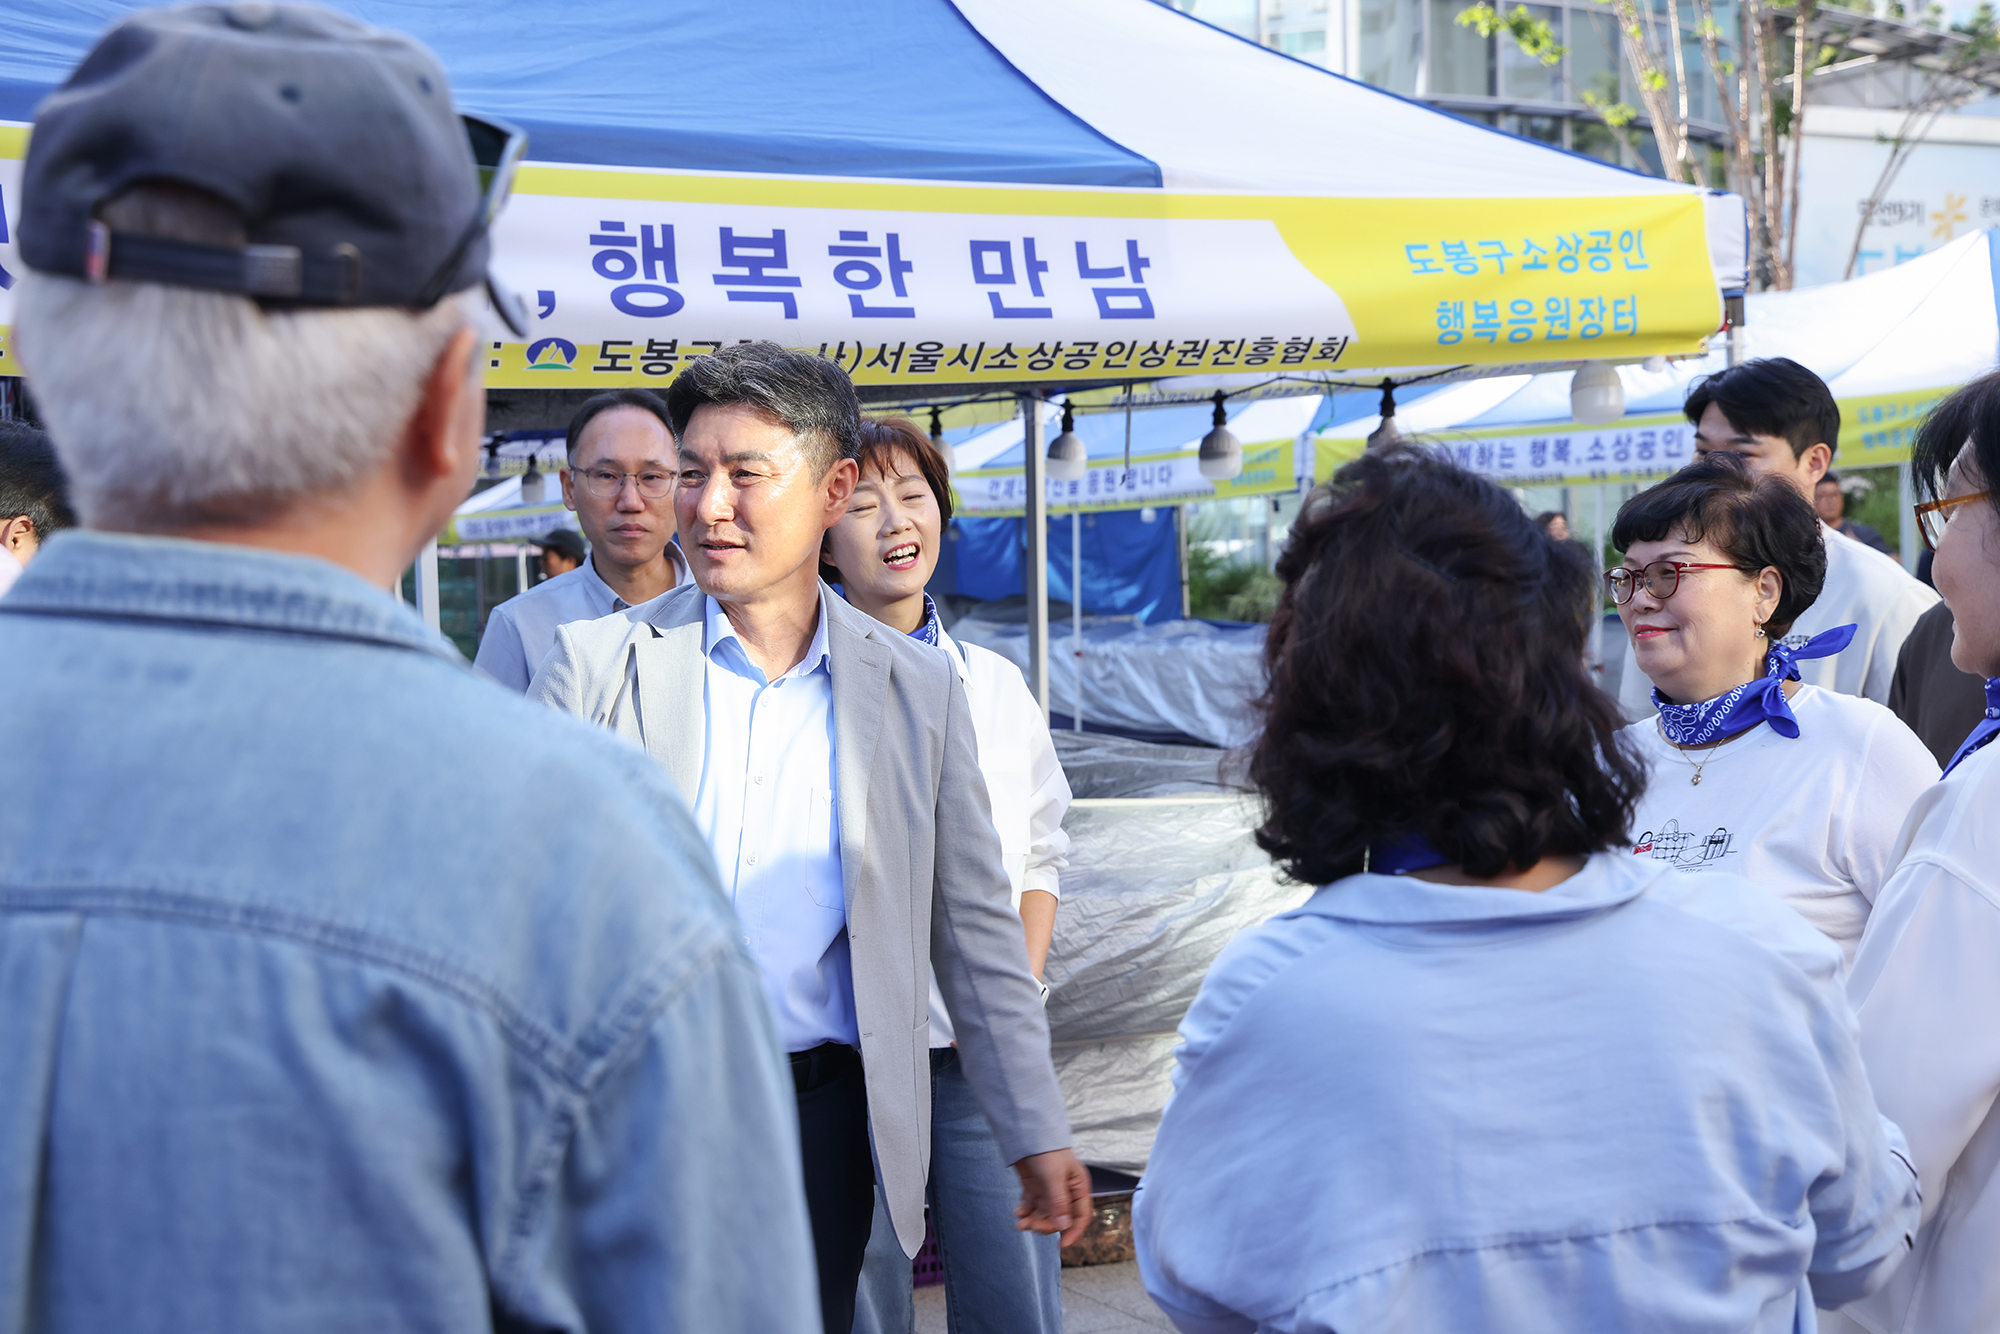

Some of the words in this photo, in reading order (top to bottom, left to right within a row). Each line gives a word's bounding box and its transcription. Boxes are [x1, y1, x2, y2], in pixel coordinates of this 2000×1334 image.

[589, 220, 916, 319] 행복한
[969, 237, 1155, 319] 만남
[1436, 294, 1639, 346] 행복응원장터
